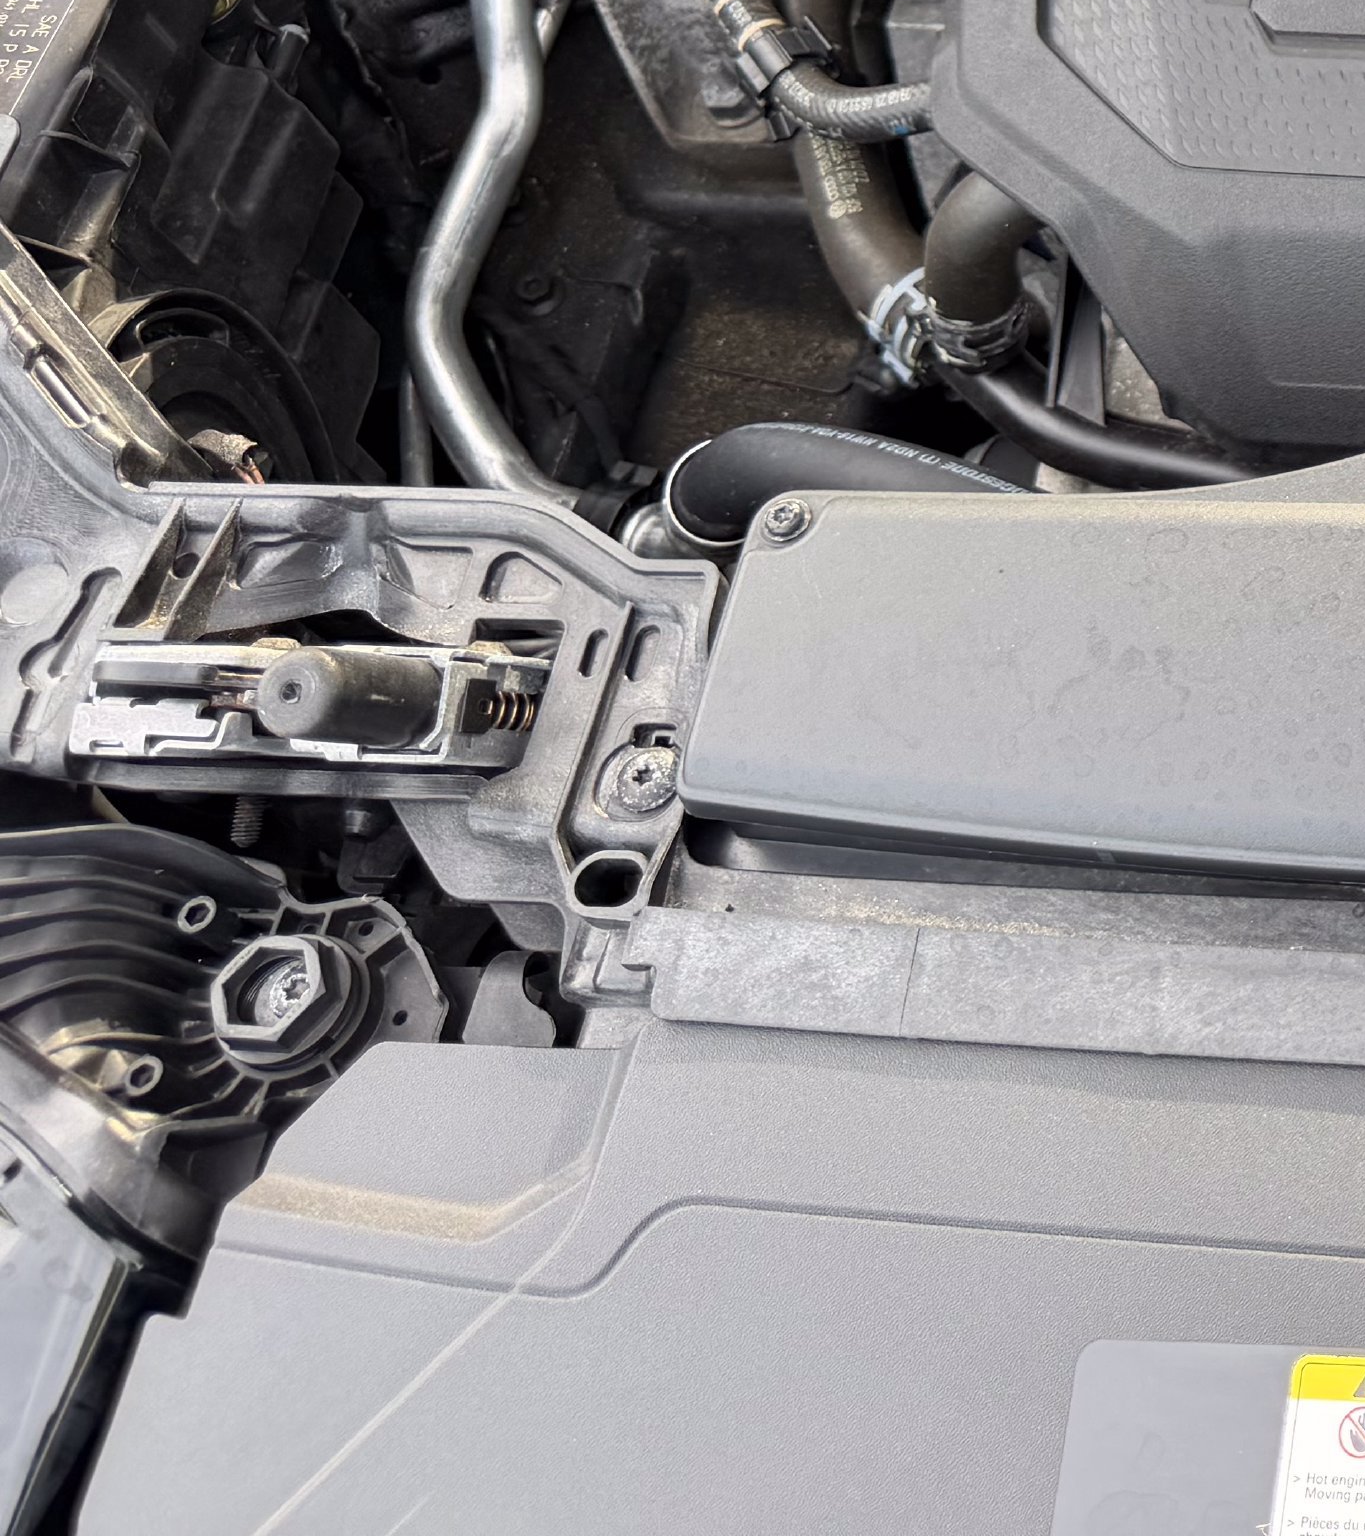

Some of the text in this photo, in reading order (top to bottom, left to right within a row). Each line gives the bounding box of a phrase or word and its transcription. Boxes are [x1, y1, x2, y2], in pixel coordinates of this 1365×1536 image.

[31, 14, 58, 38] SAE
[3, 43, 19, 53] P
[22, 44, 40, 54] A
[6, 59, 33, 83] DRL
[1306, 1472, 1328, 1486] Hot
[1304, 1487, 1351, 1504] Moving
[1343, 1518, 1360, 1531] du
